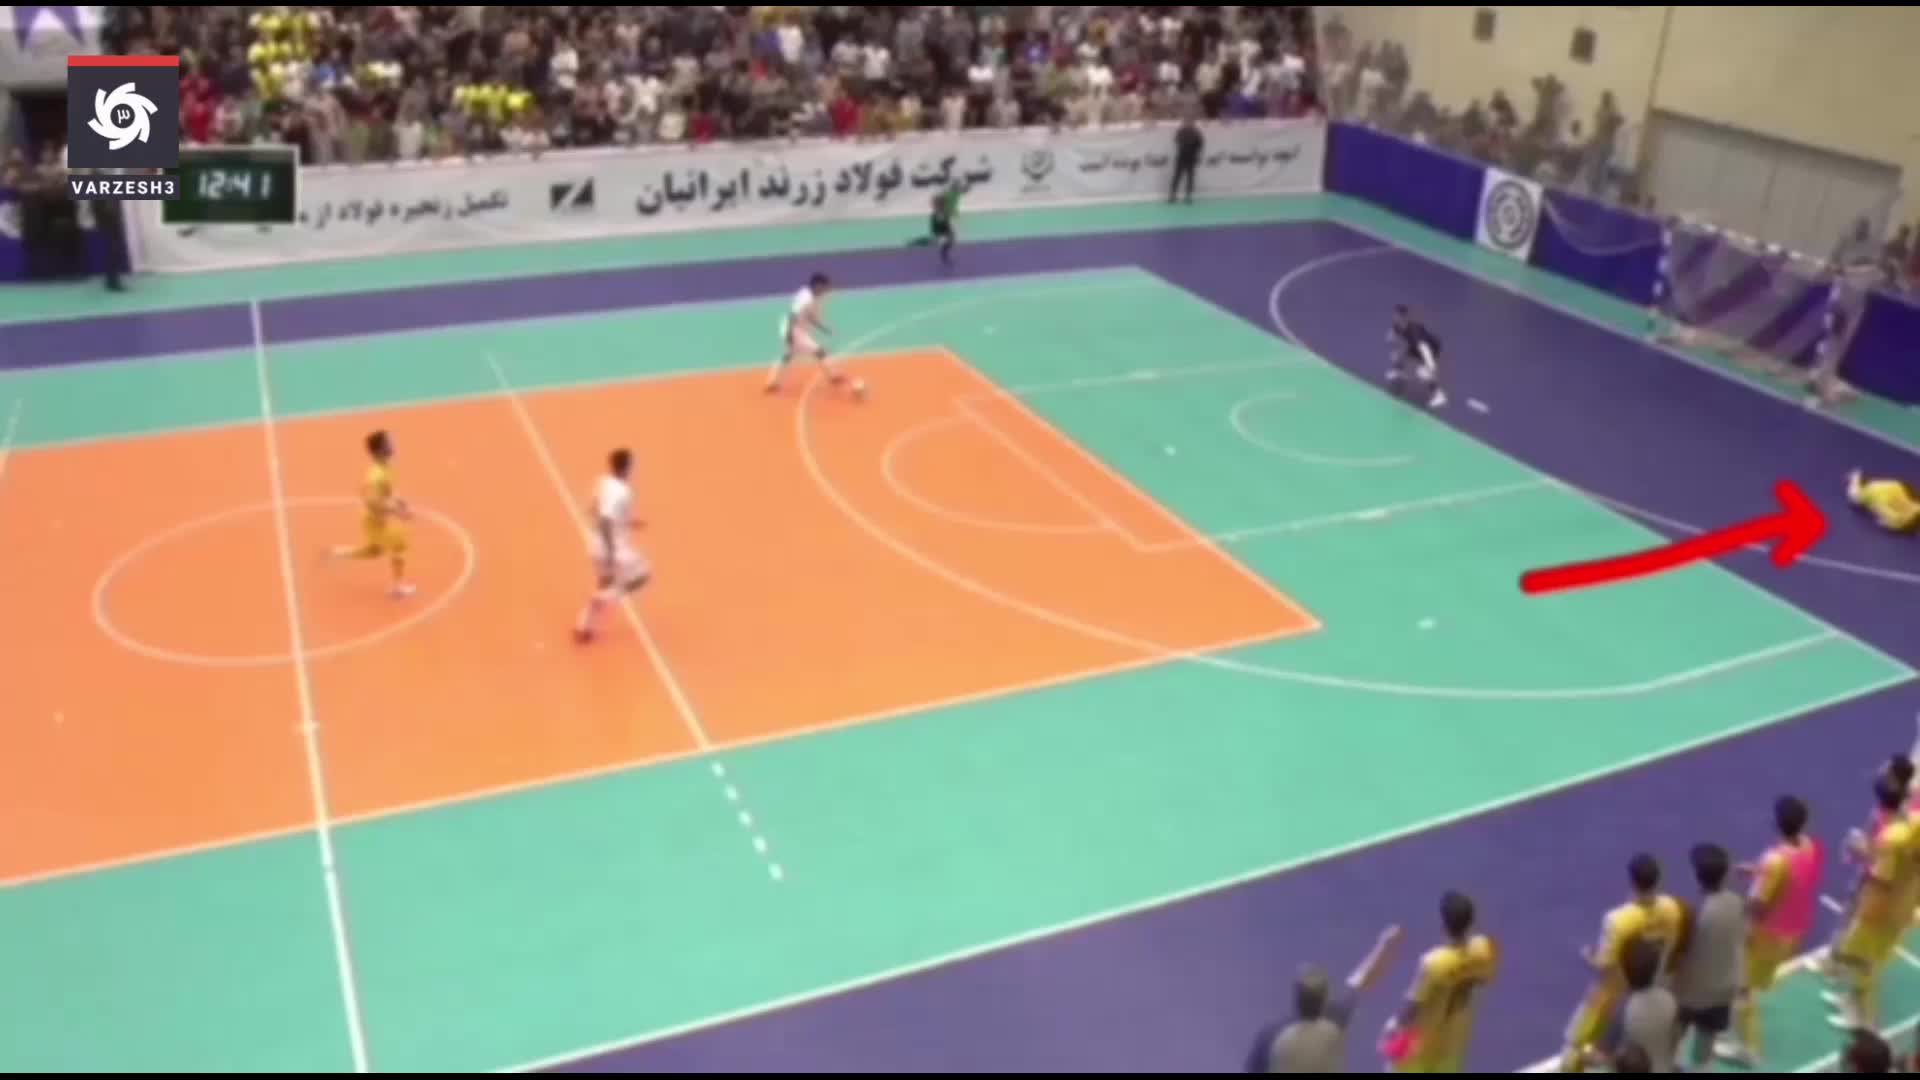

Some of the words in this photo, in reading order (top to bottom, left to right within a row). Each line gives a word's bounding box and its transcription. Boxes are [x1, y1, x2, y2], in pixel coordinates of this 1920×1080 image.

[636, 167, 750, 216] ایرانیان
[758, 163, 827, 206] زرند
[834, 160, 903, 201] فولاد
[911, 153, 992, 194] شرکت
